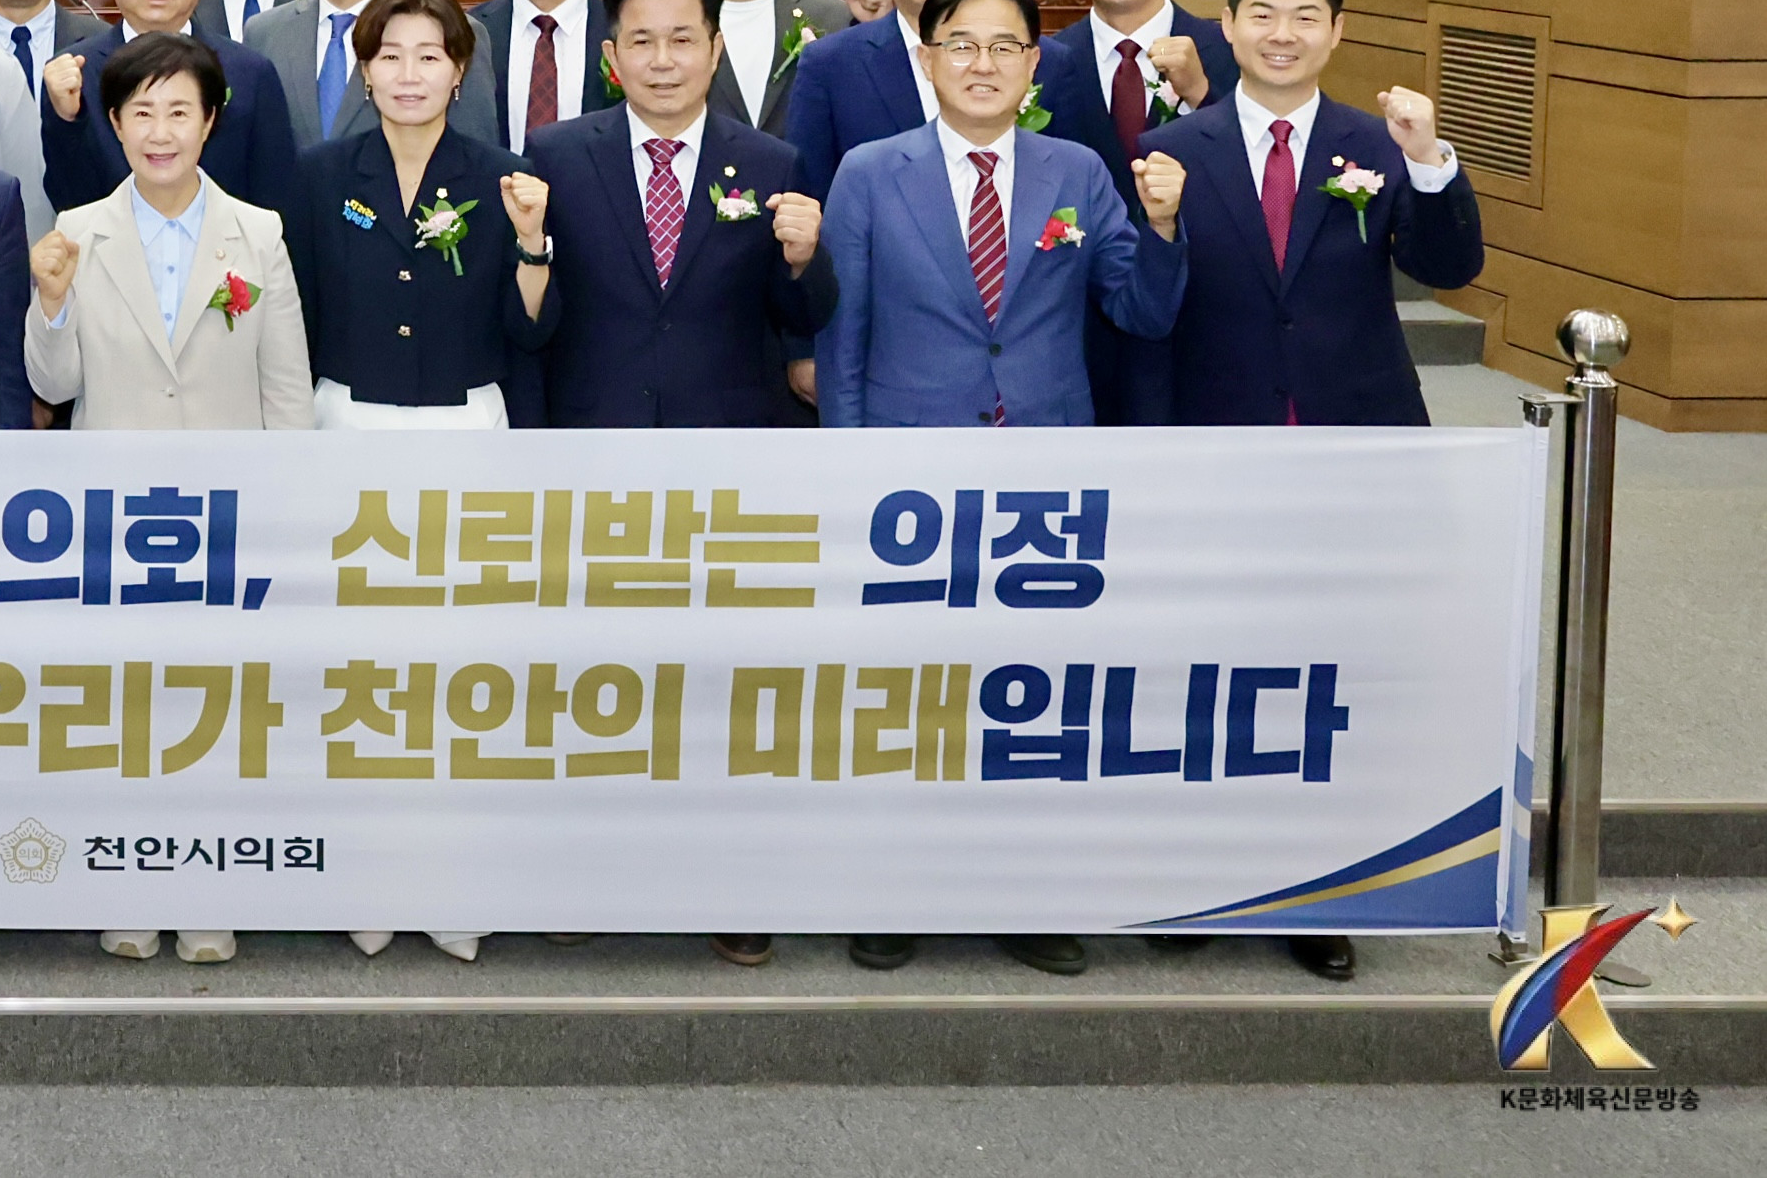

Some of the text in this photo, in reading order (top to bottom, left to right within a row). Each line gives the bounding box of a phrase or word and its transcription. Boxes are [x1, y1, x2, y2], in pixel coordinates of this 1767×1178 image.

[332, 489, 820, 607] 신뢰받는
[861, 489, 1110, 609] 의정
[321, 660, 685, 780] 천안의
[728, 662, 1349, 783] 미래입니다
[18, 847, 44, 862] 의회
[83, 836, 325, 872] 천안시의회
